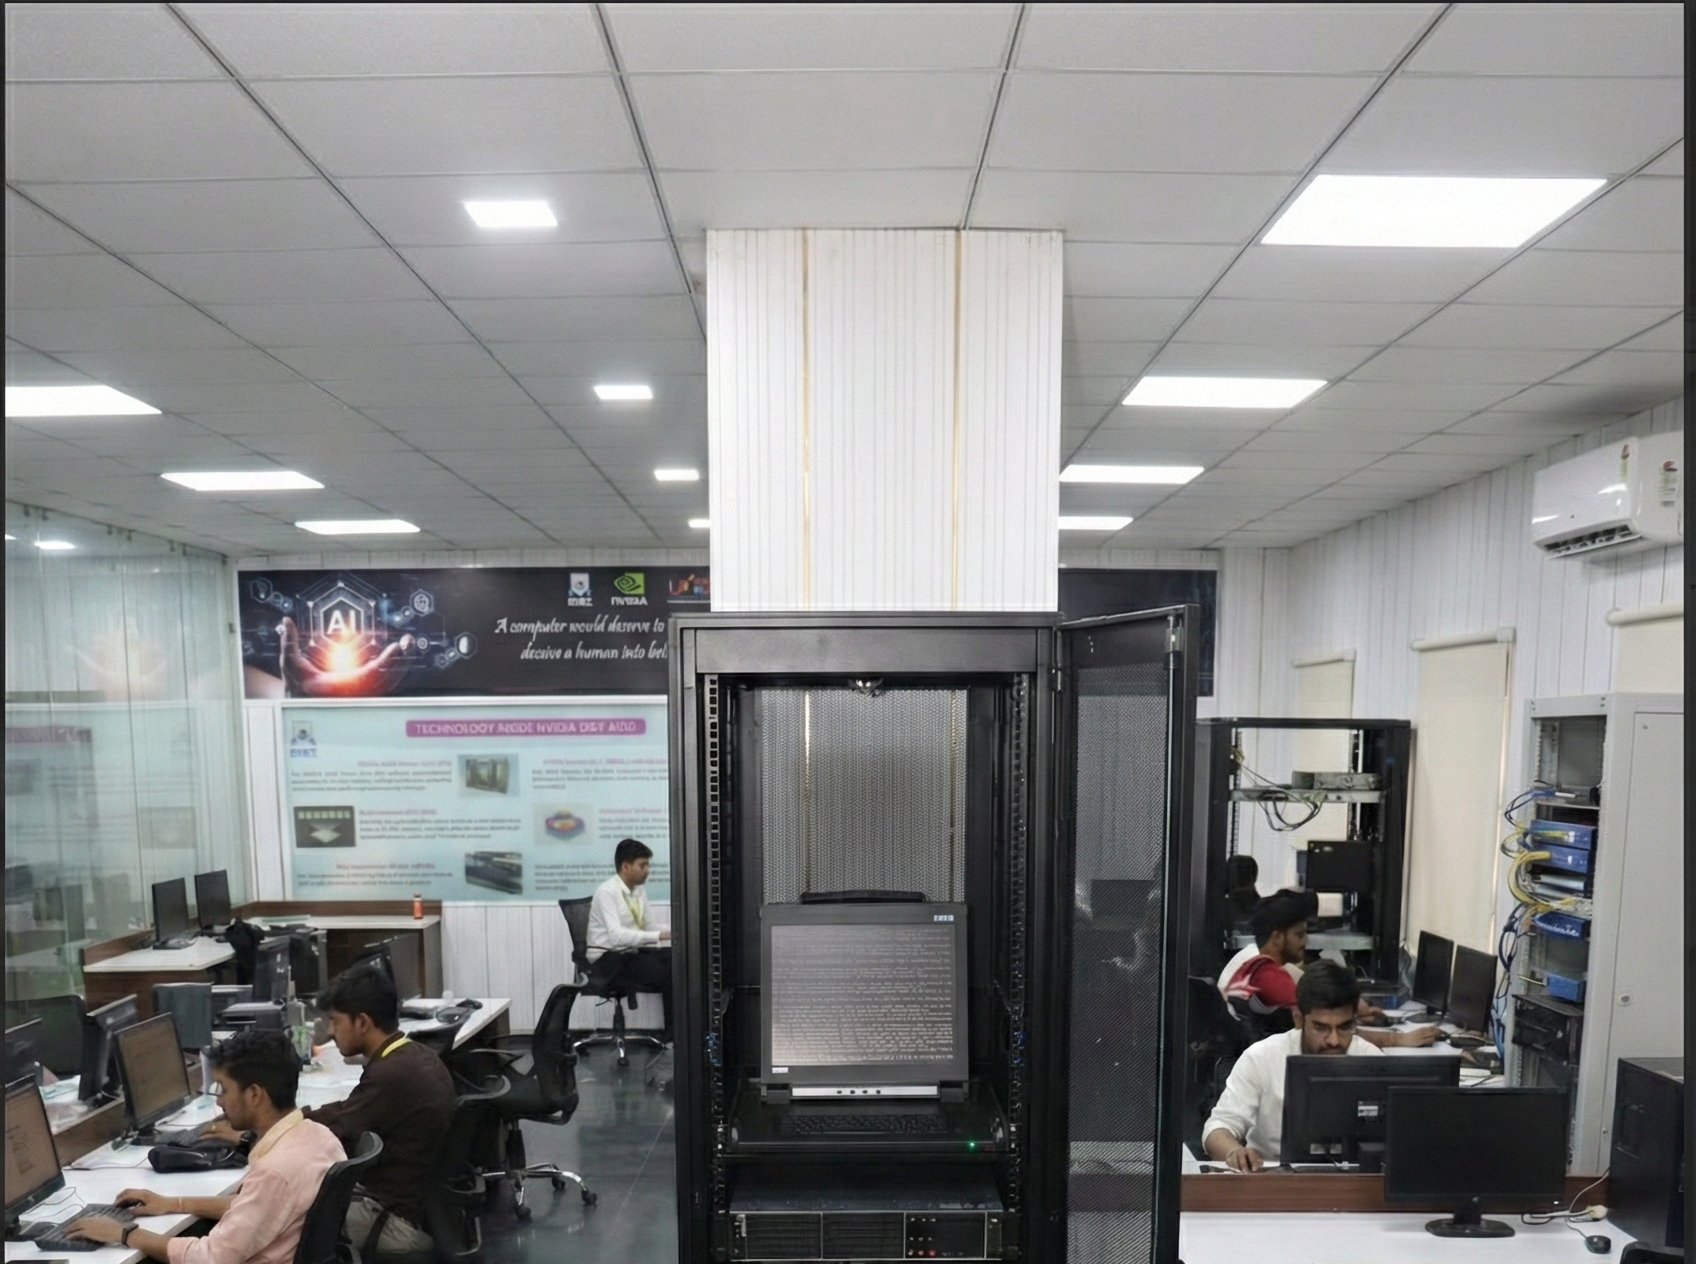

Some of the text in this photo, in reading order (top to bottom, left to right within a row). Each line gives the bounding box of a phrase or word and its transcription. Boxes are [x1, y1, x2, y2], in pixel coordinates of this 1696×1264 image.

[326, 609, 357, 635] AI
[494, 617, 508, 634] A
[510, 617, 568, 642] computer
[569, 614, 609, 634] would
[653, 617, 665, 633] to
[563, 649, 572, 660] a
[575, 641, 619, 660] human
[621, 643, 645, 660] into
[416, 723, 496, 735] TECHNOLOGY
